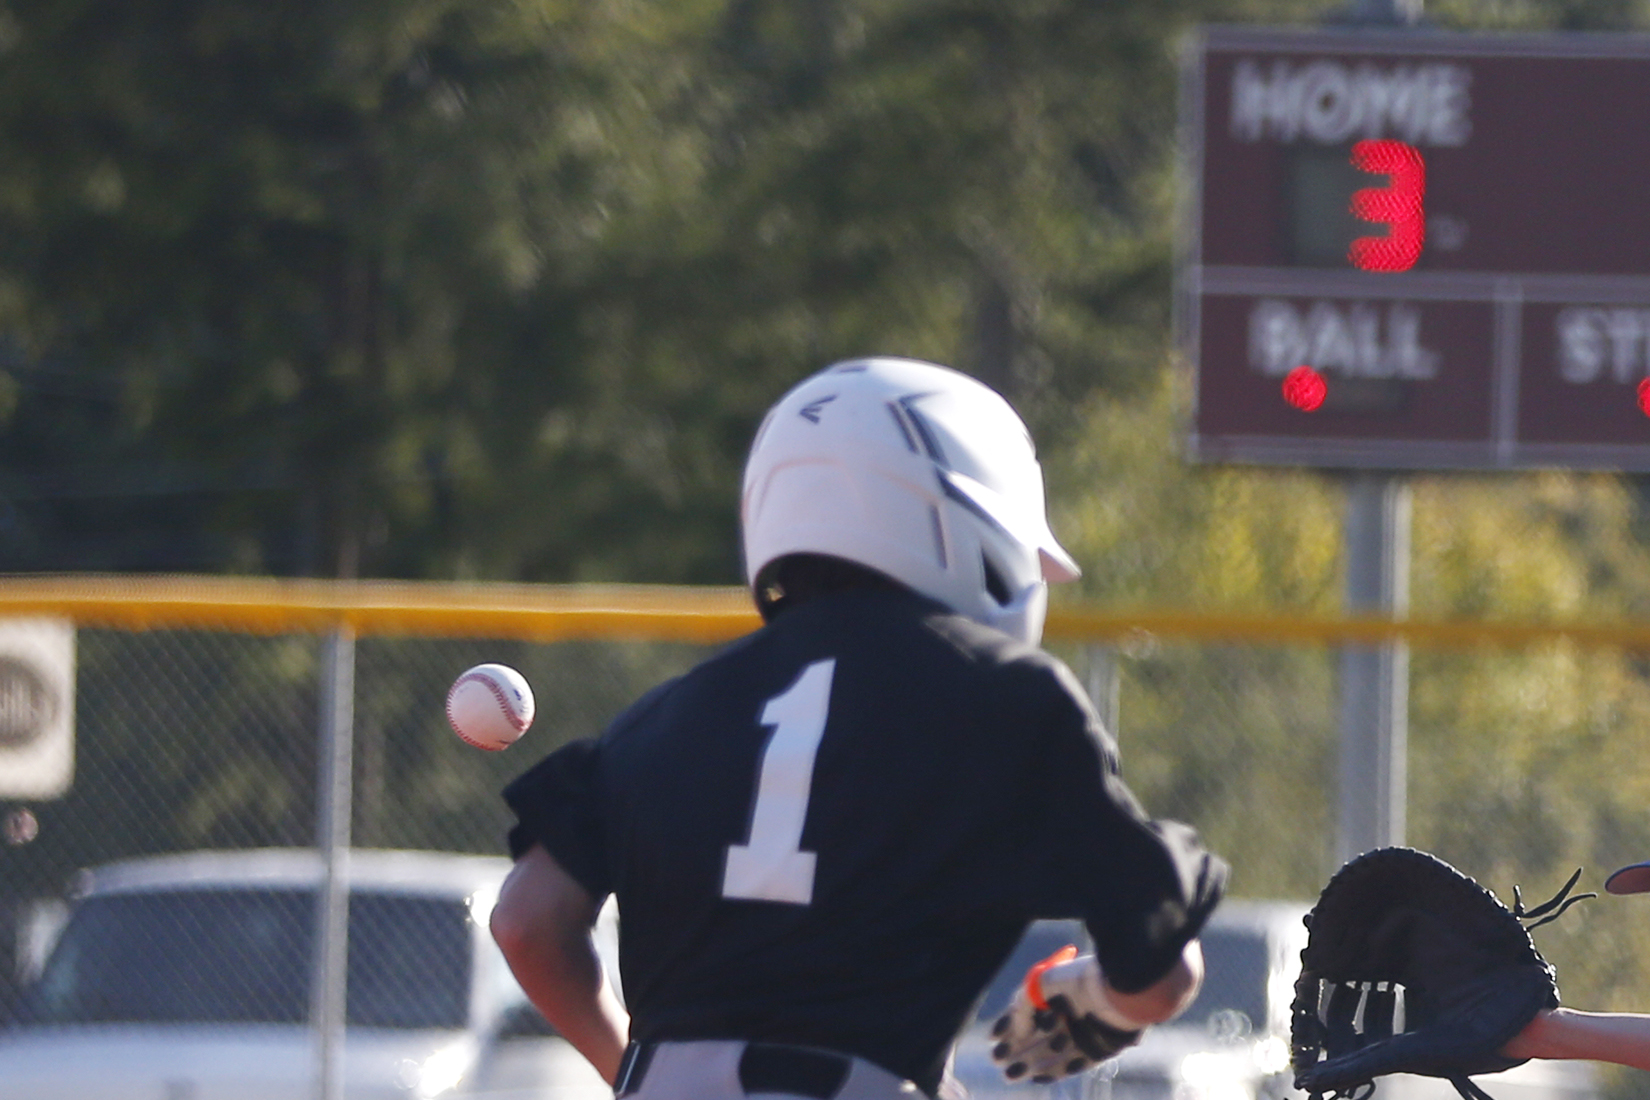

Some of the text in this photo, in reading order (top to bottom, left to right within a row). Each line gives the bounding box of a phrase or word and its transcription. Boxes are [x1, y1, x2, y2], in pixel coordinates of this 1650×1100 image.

[1231, 60, 1472, 146] HOME
[1347, 138, 1426, 272] 3
[1248, 300, 1440, 379] BALL
[721, 656, 837, 905] 1
